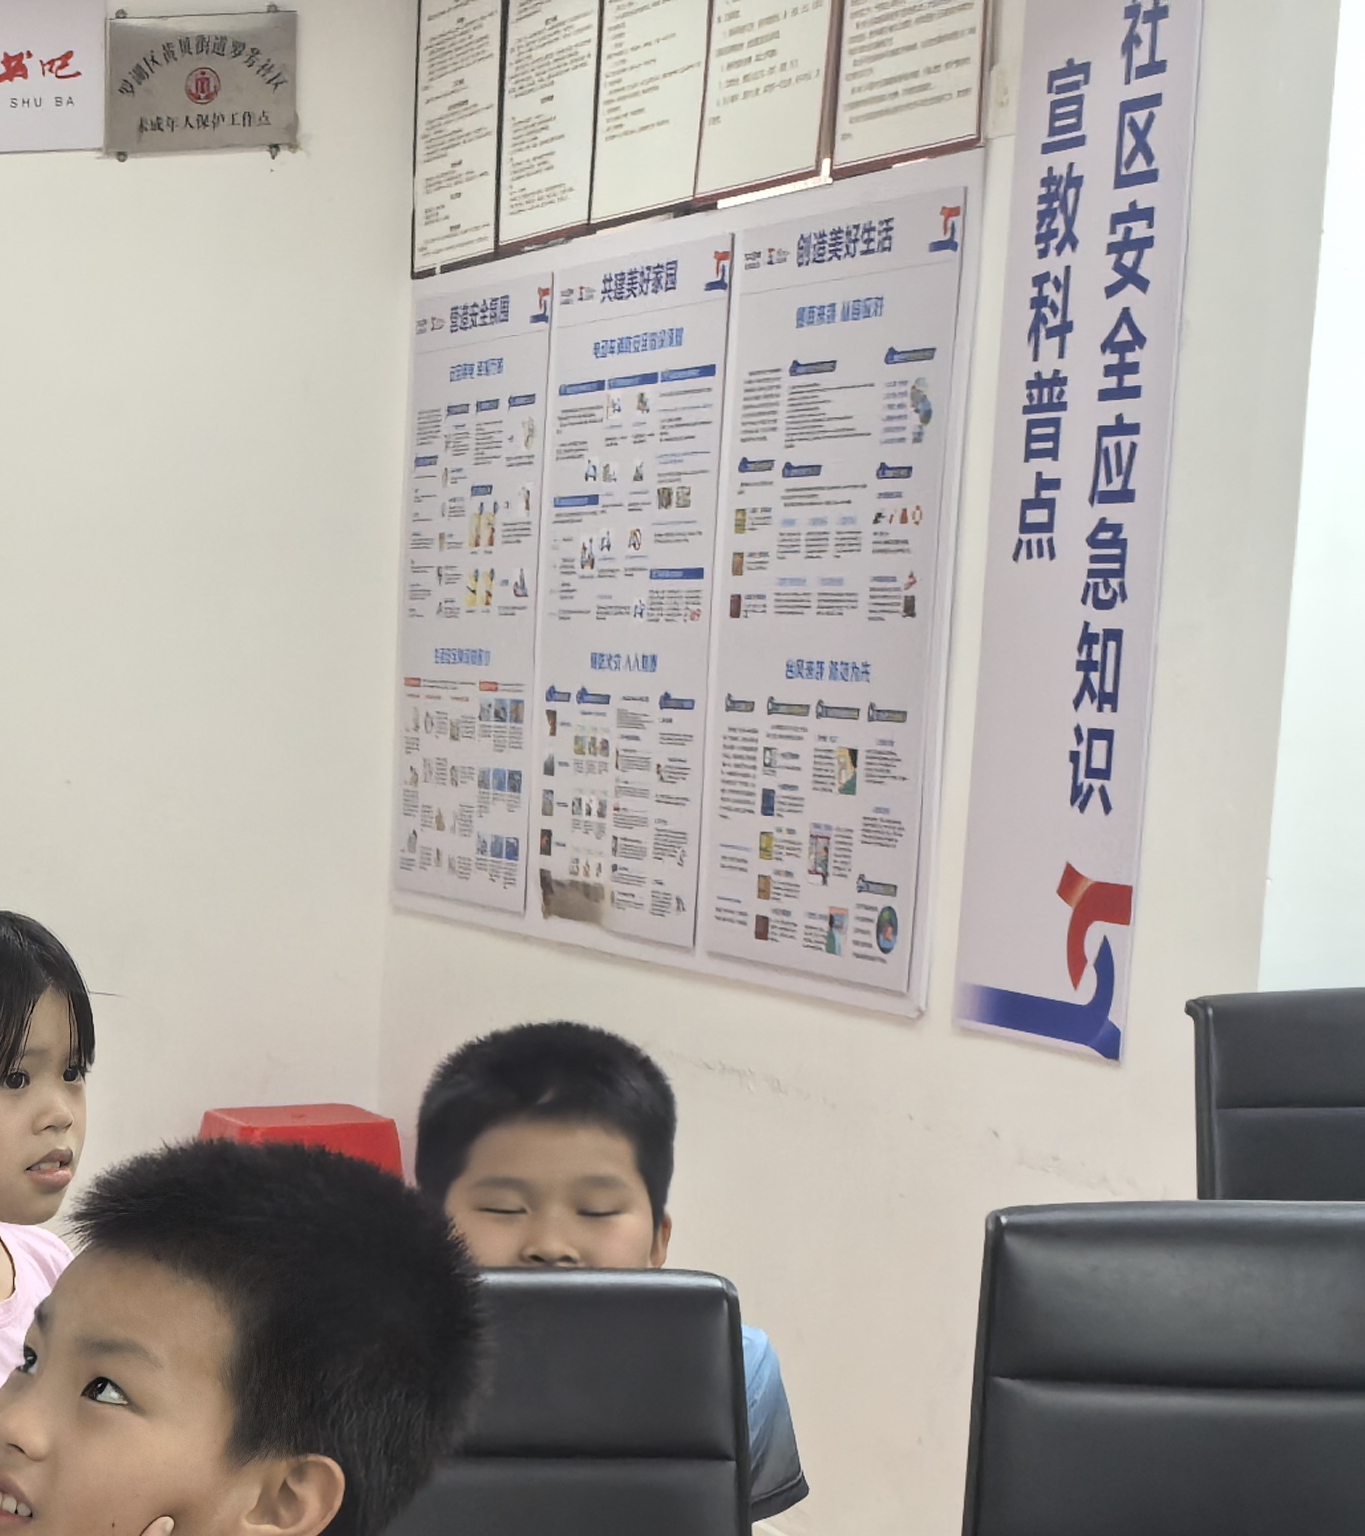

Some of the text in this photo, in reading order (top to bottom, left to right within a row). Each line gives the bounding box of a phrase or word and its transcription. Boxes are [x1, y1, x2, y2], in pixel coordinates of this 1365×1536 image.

[9, 97, 43, 109] SHU
[55, 96, 75, 108] BA
[1012, 58, 1092, 563] 宣教科普点
[1069, 0, 1170, 816] 社区安全应急知识
